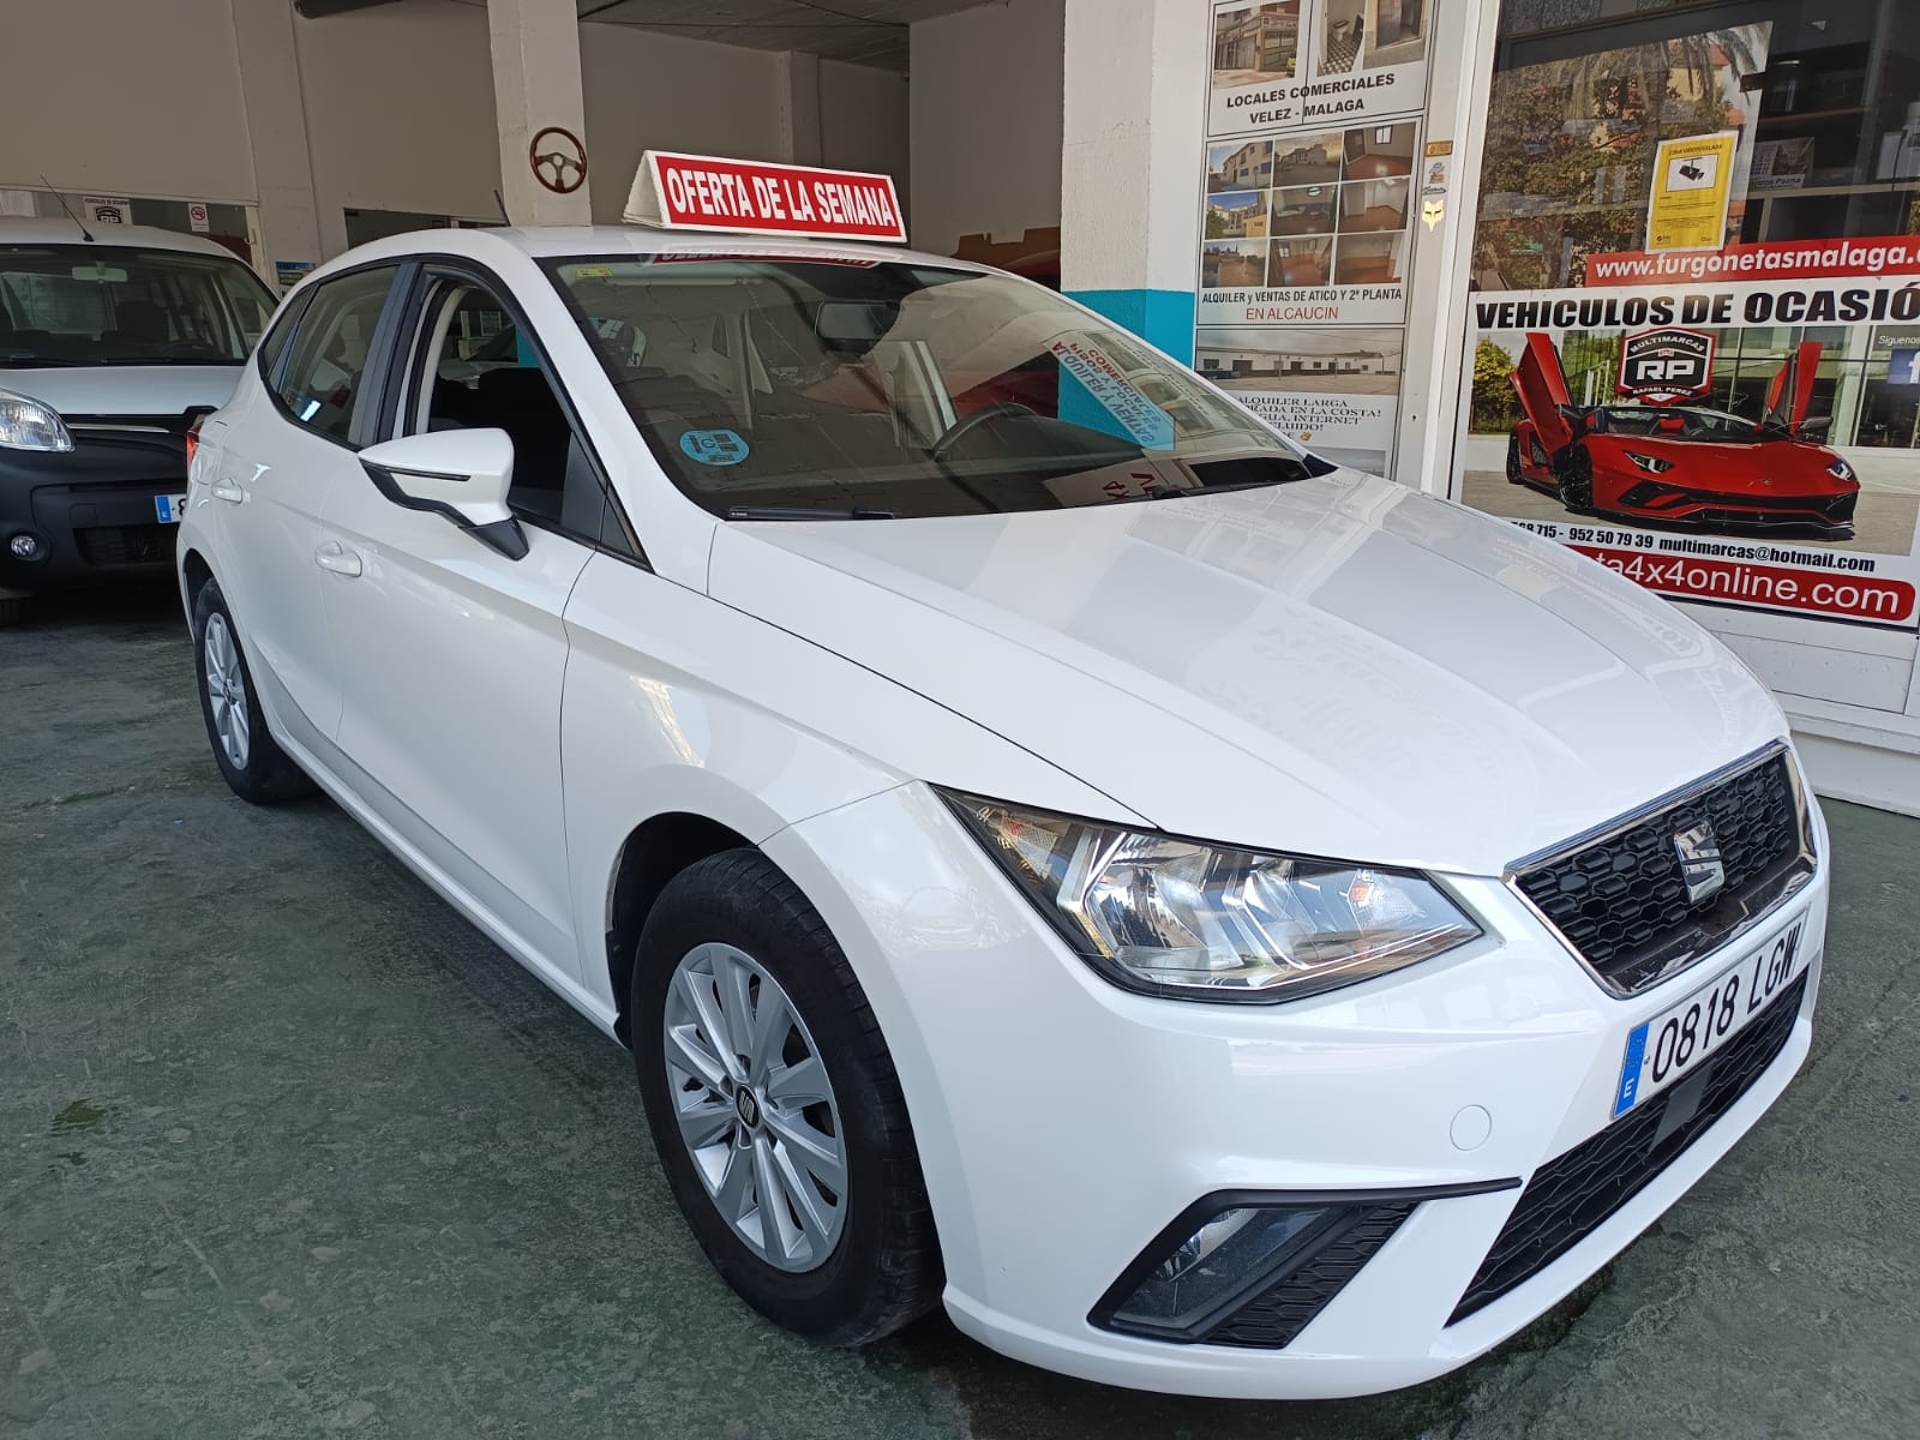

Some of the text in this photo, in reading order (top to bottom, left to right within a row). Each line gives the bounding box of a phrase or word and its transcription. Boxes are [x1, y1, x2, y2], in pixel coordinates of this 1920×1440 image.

[1226, 73, 1395, 108] LOCALES COMERCIALES
[1250, 108, 1292, 124] VELEZ
[1304, 98, 1364, 117] MALAGA
[666, 167, 897, 227] OFERTA DE LA SEMANA
[1596, 243, 1920, 278] www.furgonetasmalaga.
[1202, 292, 1246, 303] ALQUILER
[1255, 291, 1290, 302] VENTAS
[1294, 290, 1306, 300] DE
[1308, 290, 1337, 300] ATICO
[1340, 290, 1348, 300] Y
[1362, 288, 1402, 300] PLANTA
[1246, 306, 1338, 320] EN ALCAUCIN
[1476, 296, 1673, 328] VEHICULOS
[1682, 294, 1734, 323] DE
[1630, 336, 1704, 353] MULTIMARCAS
[1636, 360, 1694, 380] RP
[1632, 386, 1692, 396] RAFAEL PEREZ
[1246, 404, 1286, 414] RADA
[1290, 406, 1308, 414] EN
[1330, 408, 1381, 417] COSTA!
[1304, 398, 1348, 408] LARGA
[1294, 414, 1362, 425] INTERNET
[1537, 524, 1557, 538] 715
[1569, 528, 1594, 542] 952
[1596, 530, 1614, 544] 50
[1617, 532, 1633, 546] 79
[1635, 534, 1654, 548] 39
[1659, 538, 1876, 572] multimarcas@hotmail.com
[1652, 922, 1802, 1083] 0818 LGW
[1624, 1078, 1634, 1098] E
